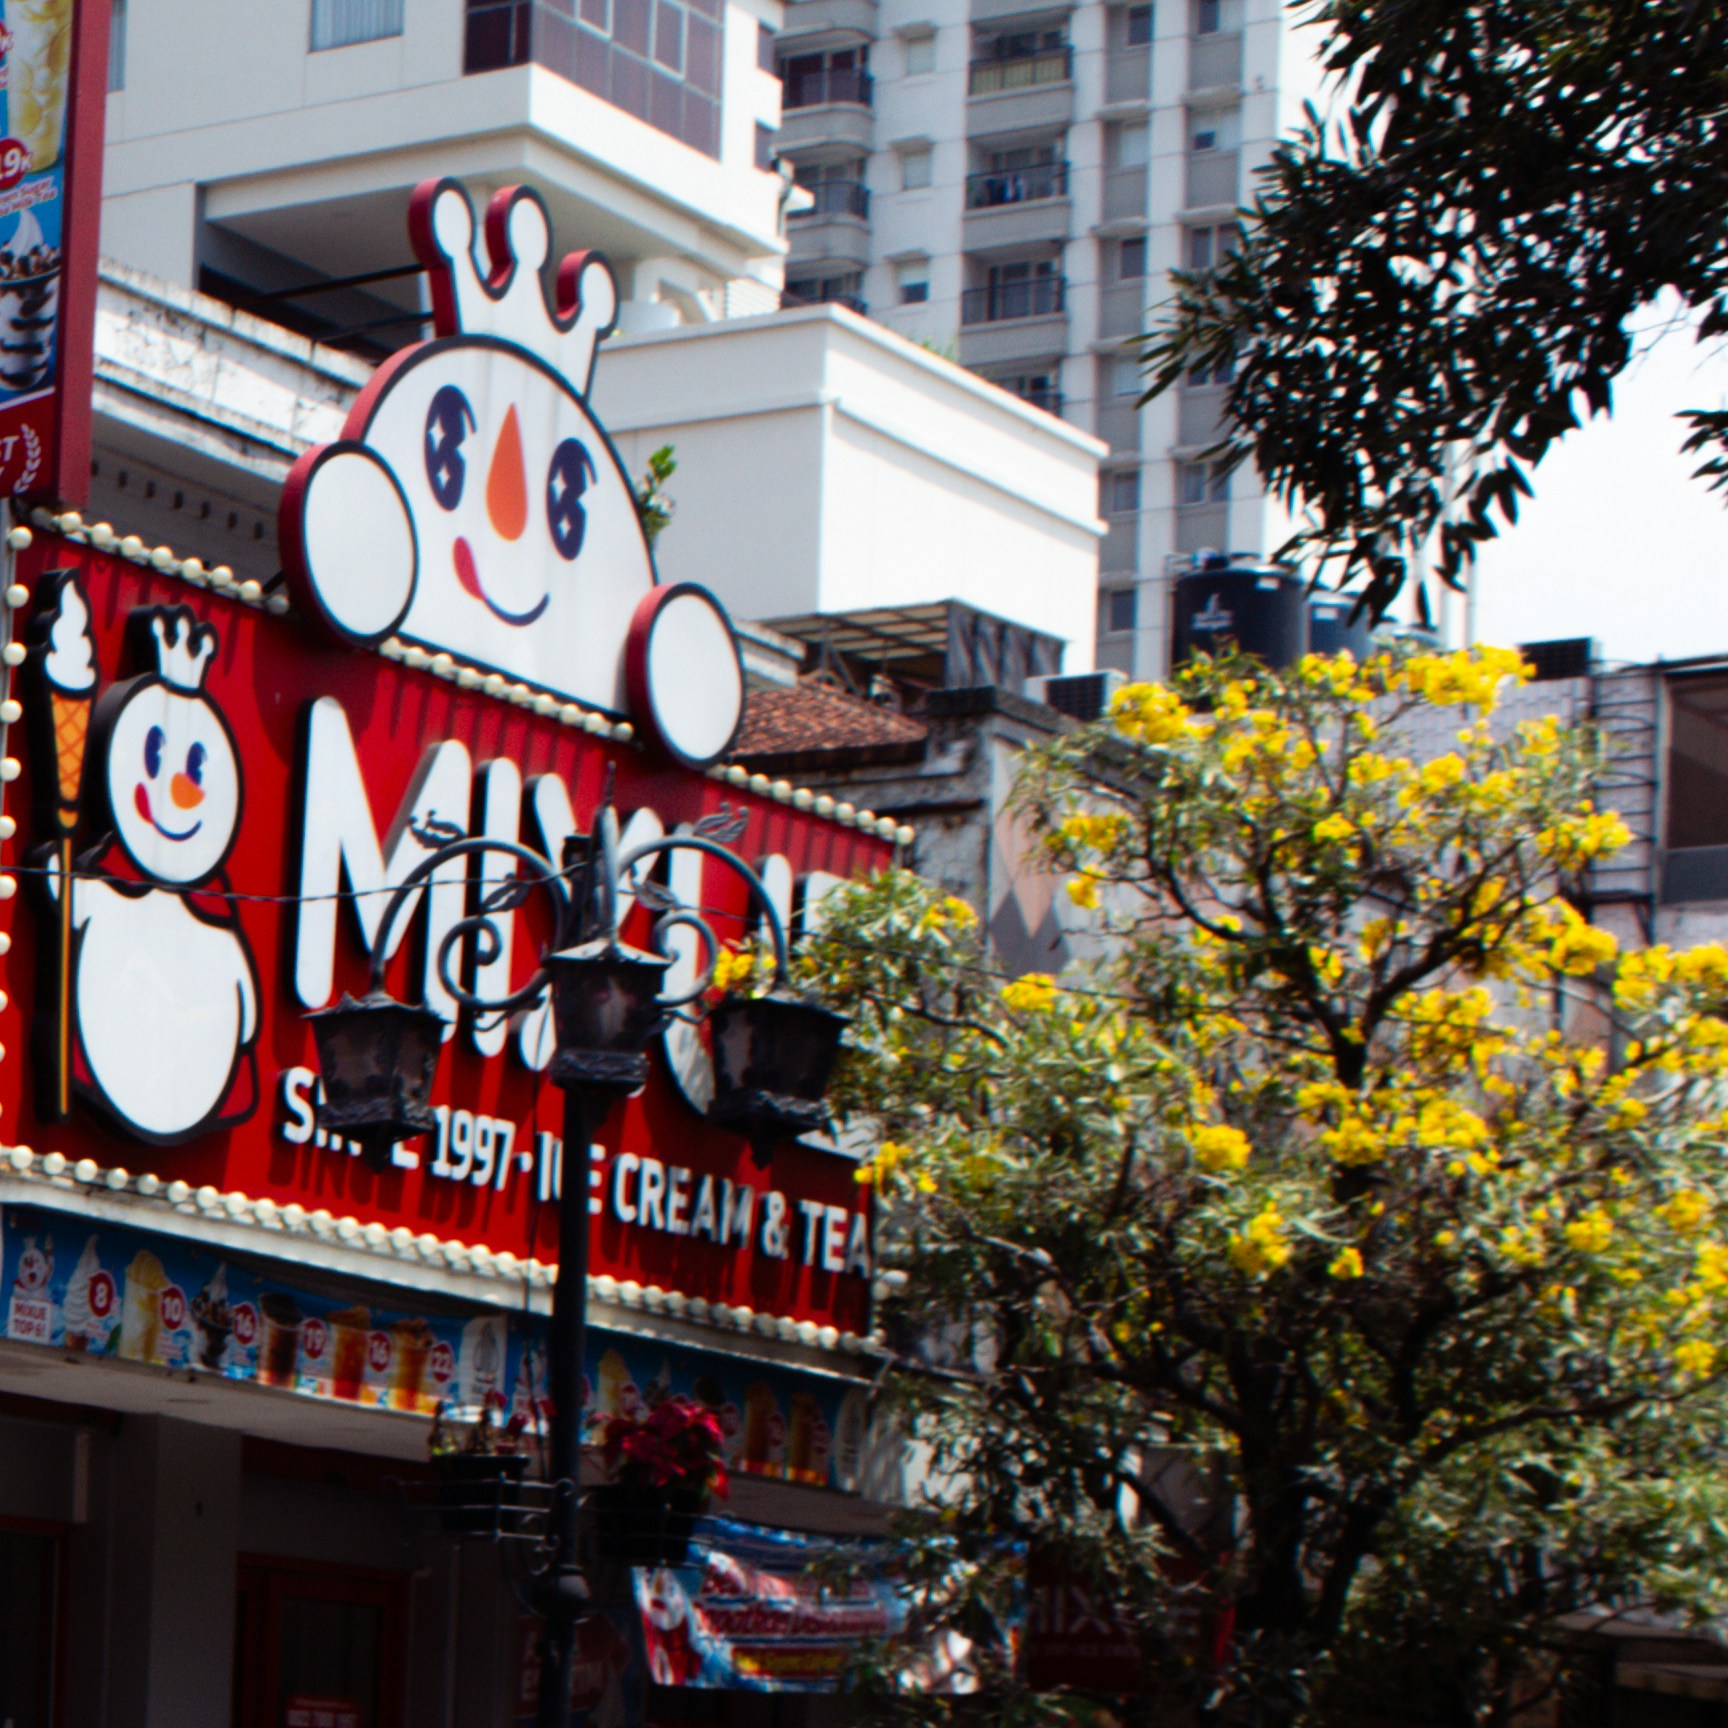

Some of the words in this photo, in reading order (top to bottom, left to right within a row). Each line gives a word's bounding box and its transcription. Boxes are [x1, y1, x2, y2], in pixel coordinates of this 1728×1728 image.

[431, 1104, 517, 1191] 1997
[613, 1153, 753, 1249] CREAM
[761, 1190, 788, 1260] &
[800, 1199, 872, 1279] TEA
[94, 1283, 107, 1304] 8
[164, 1297, 182, 1319] 10
[305, 1328, 324, 1349] 19
